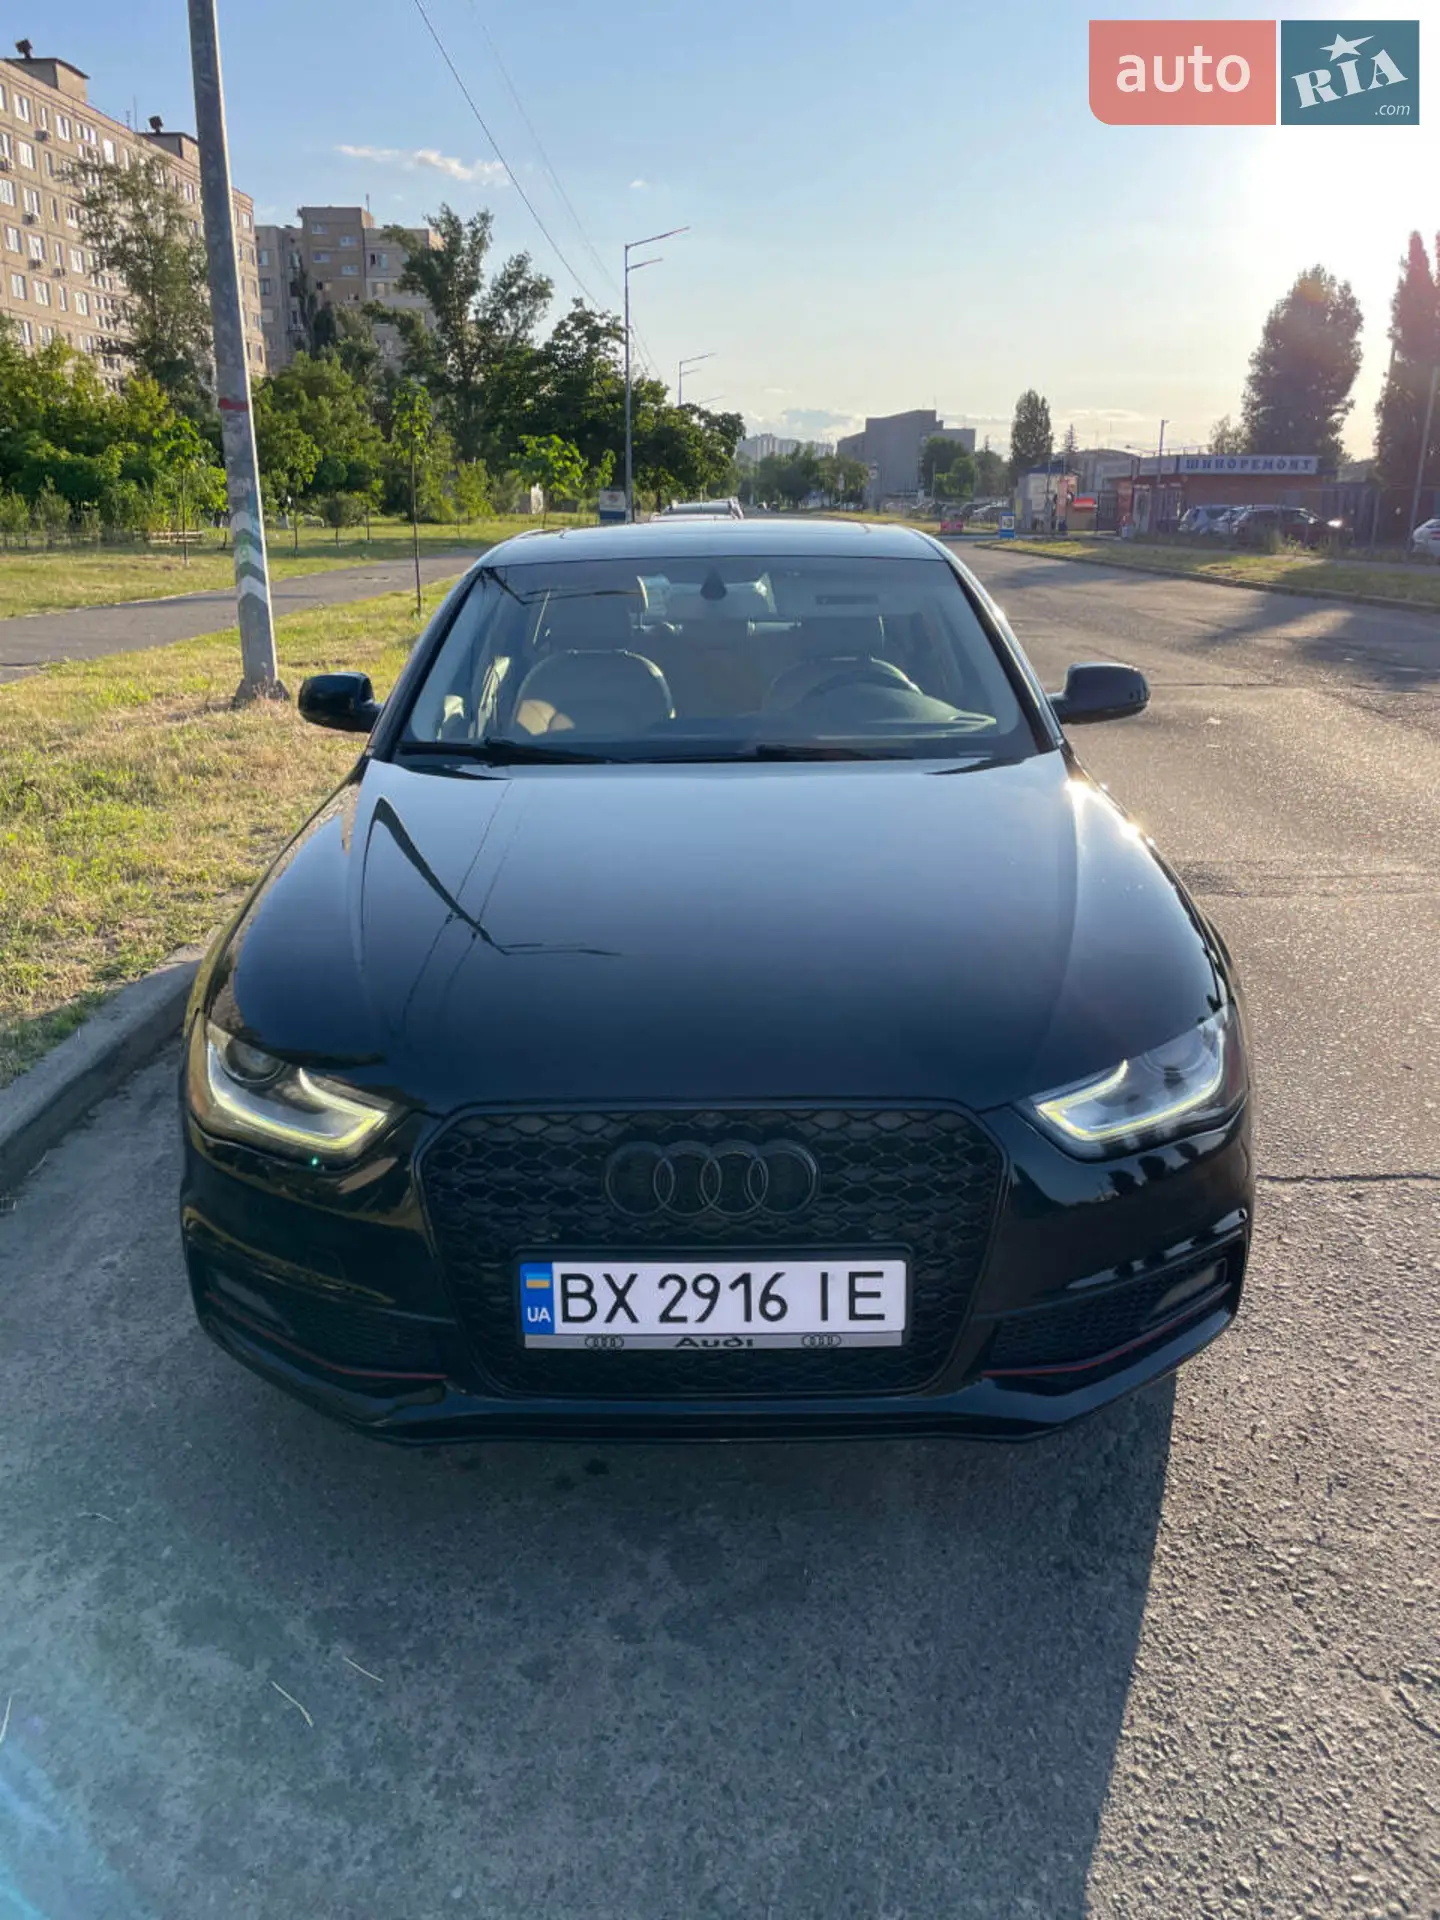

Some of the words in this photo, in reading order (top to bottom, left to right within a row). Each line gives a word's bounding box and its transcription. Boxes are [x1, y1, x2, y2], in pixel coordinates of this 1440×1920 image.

[1186, 457, 1313, 471] ШИНОРЕМОНТ
[560, 1273, 639, 1323] BX
[658, 1272, 788, 1323] 2916
[820, 1271, 886, 1322] IE
[527, 1306, 551, 1323] UA
[674, 1336, 754, 1348] Audi
